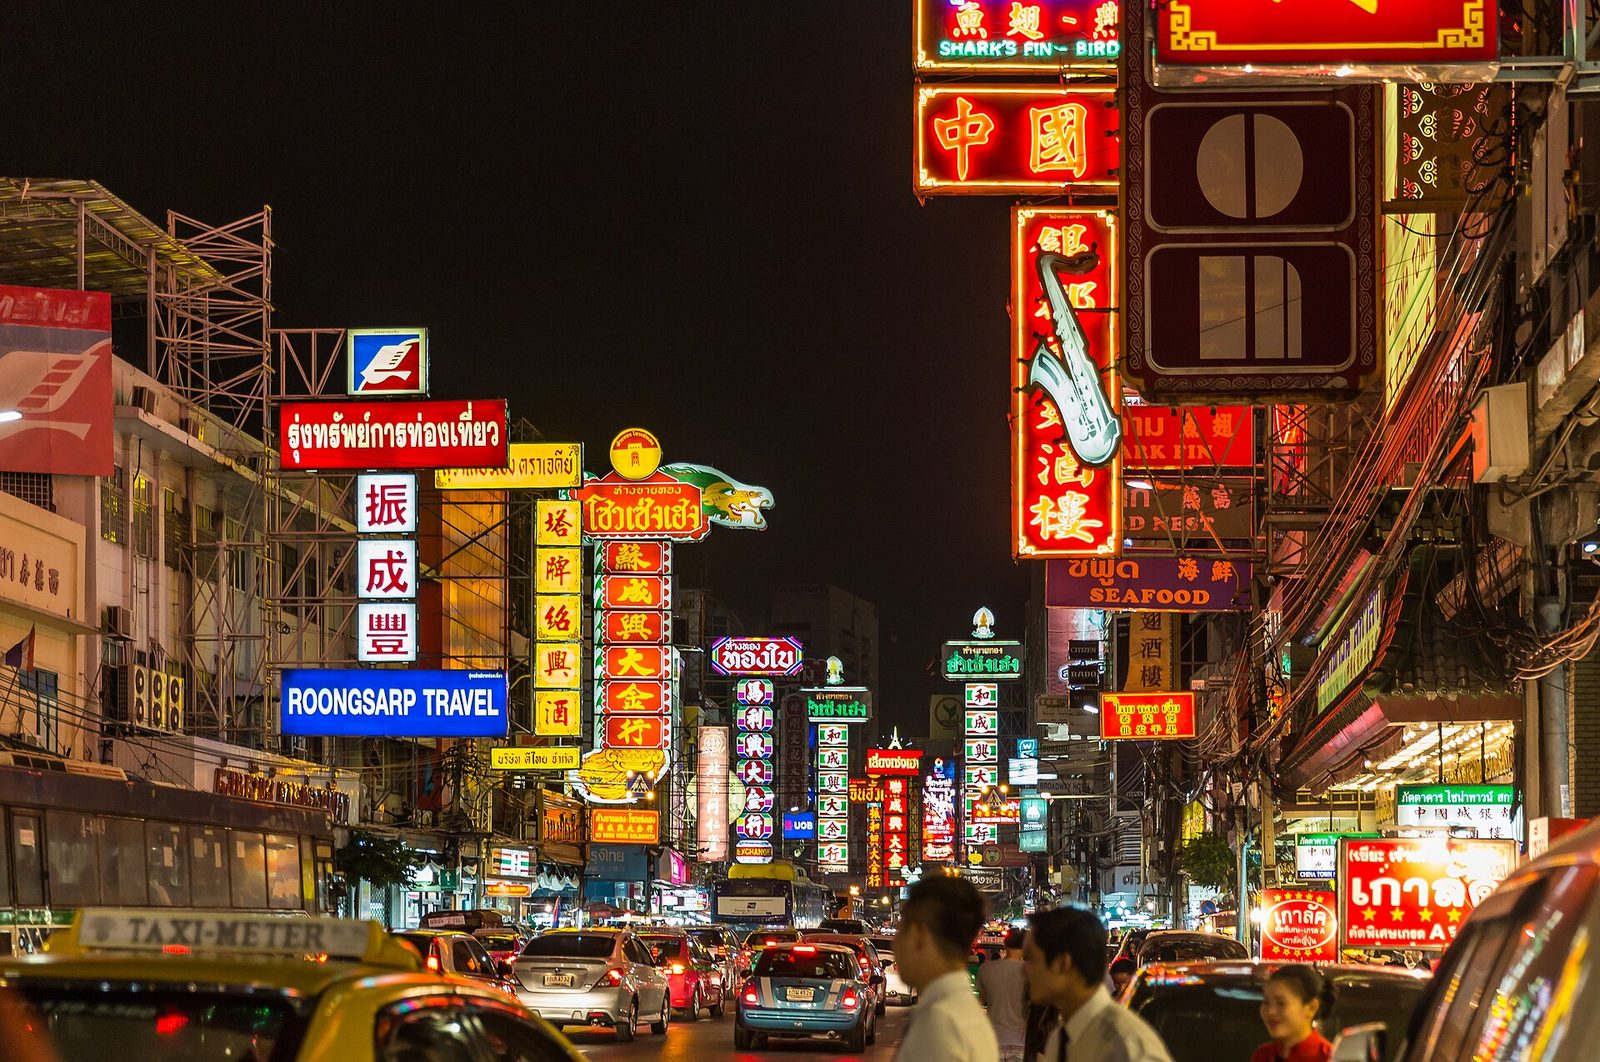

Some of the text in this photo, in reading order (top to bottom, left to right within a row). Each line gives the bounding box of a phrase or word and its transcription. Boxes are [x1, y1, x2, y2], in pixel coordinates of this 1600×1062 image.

[939, 40, 1018, 57] SHARK'S
[1075, 40, 1120, 57] BIRD
[934, 96, 1088, 182] 中國
[1029, 224, 1104, 543] 銀酒樓
[287, 401, 500, 465] รุ่งทรัพย์การท่องเที่ยว
[1181, 412, 1234, 438] 魚翅
[1173, 444, 1213, 460] FIN
[1153, 516, 1215, 532] NEST
[365, 484, 409, 655] 振成豐
[1177, 558, 1233, 583] 海鮮
[1090, 588, 1210, 605] SEAFOOD
[544, 508, 574, 727] 塔牌紹興酒
[288, 687, 499, 716] ROONGSARP TRAVEL
[973, 688, 990, 841] 和成興大行
[794, 821, 814, 830] UOB
[128, 917, 325, 948] TAXI-METER
[1429, 924, 1446, 940] A
